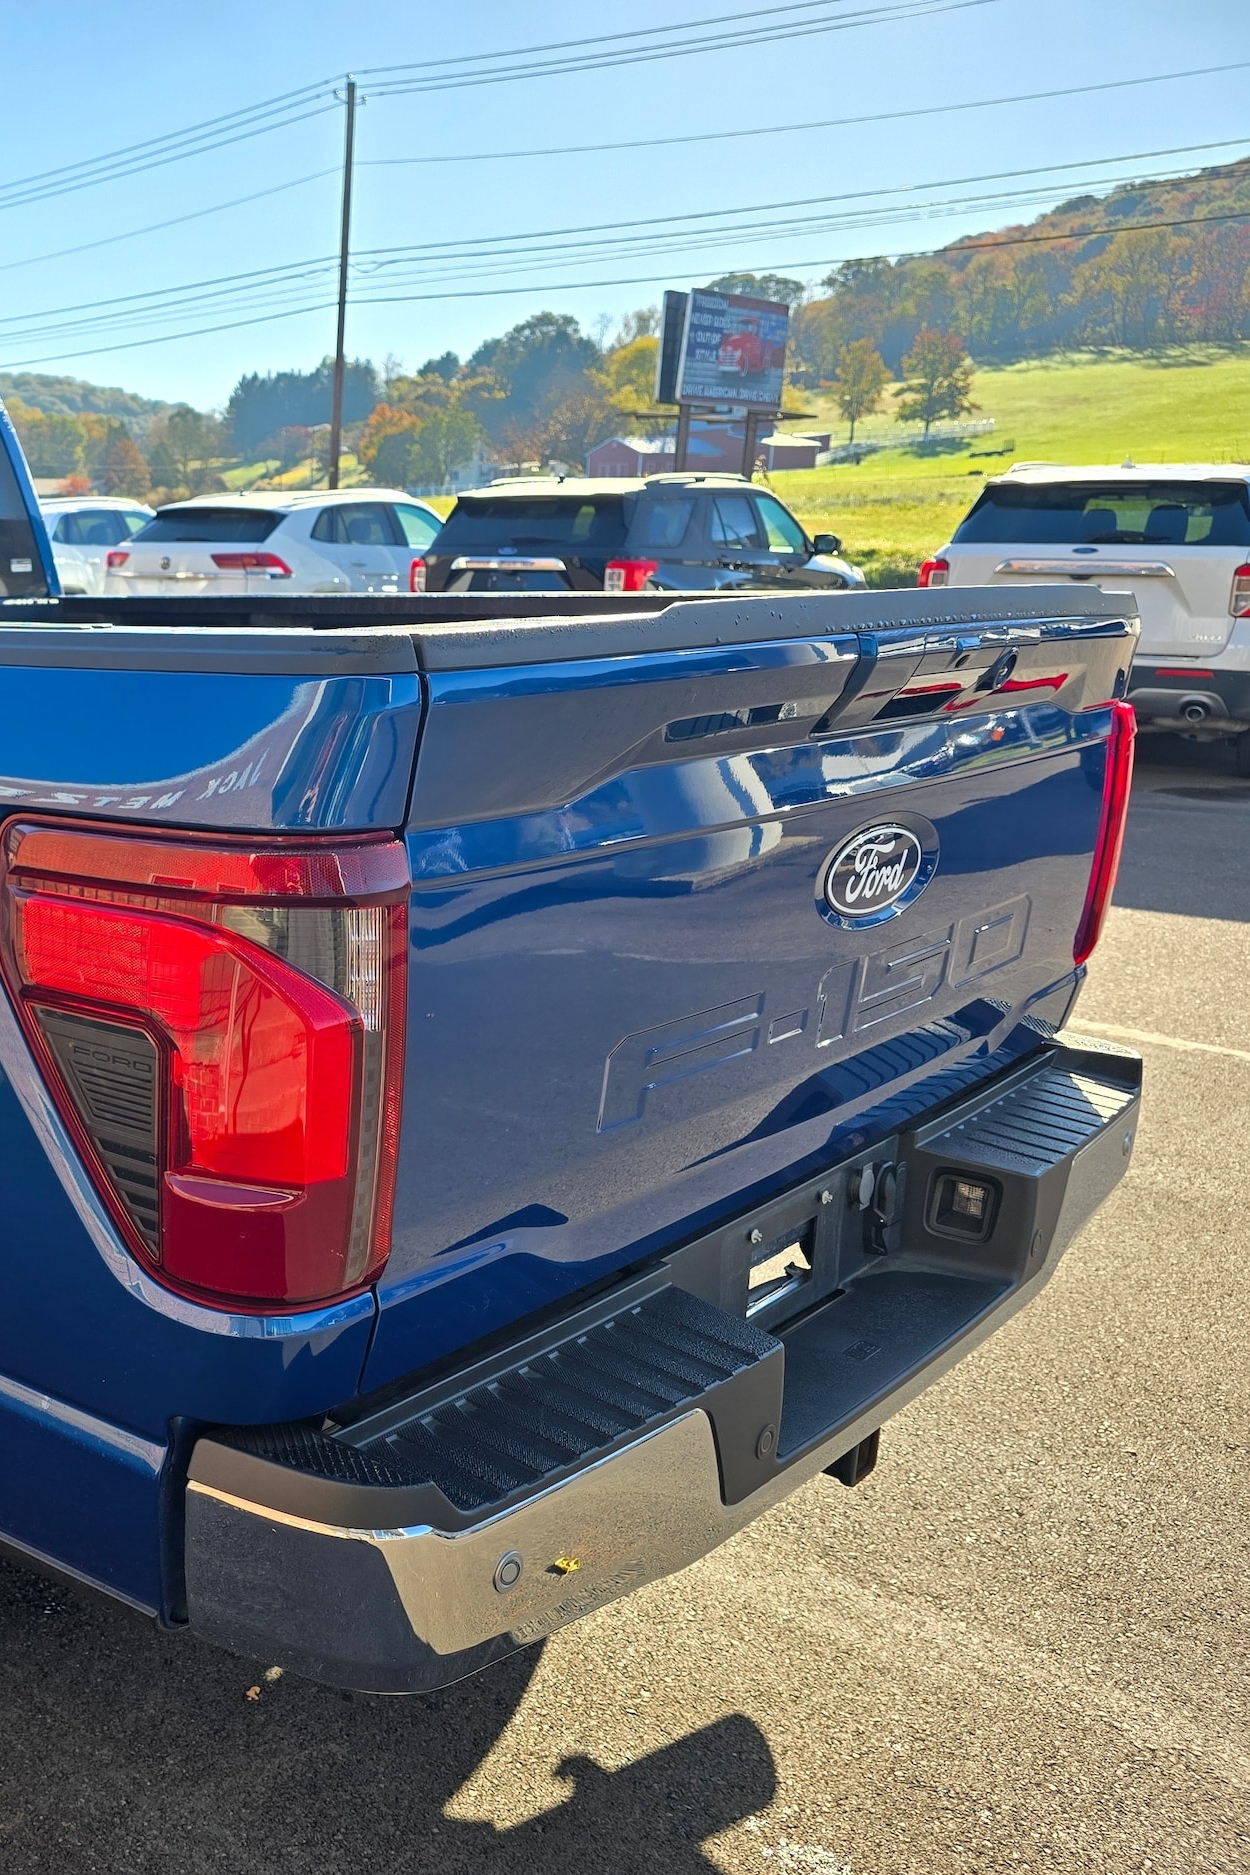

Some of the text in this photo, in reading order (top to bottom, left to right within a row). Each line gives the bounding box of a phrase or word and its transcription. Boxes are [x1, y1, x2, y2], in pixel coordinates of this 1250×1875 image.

[846, 840, 909, 903] Ford
[596, 892, 1032, 1133] F-150
[73, 1046, 153, 1074] FORD
